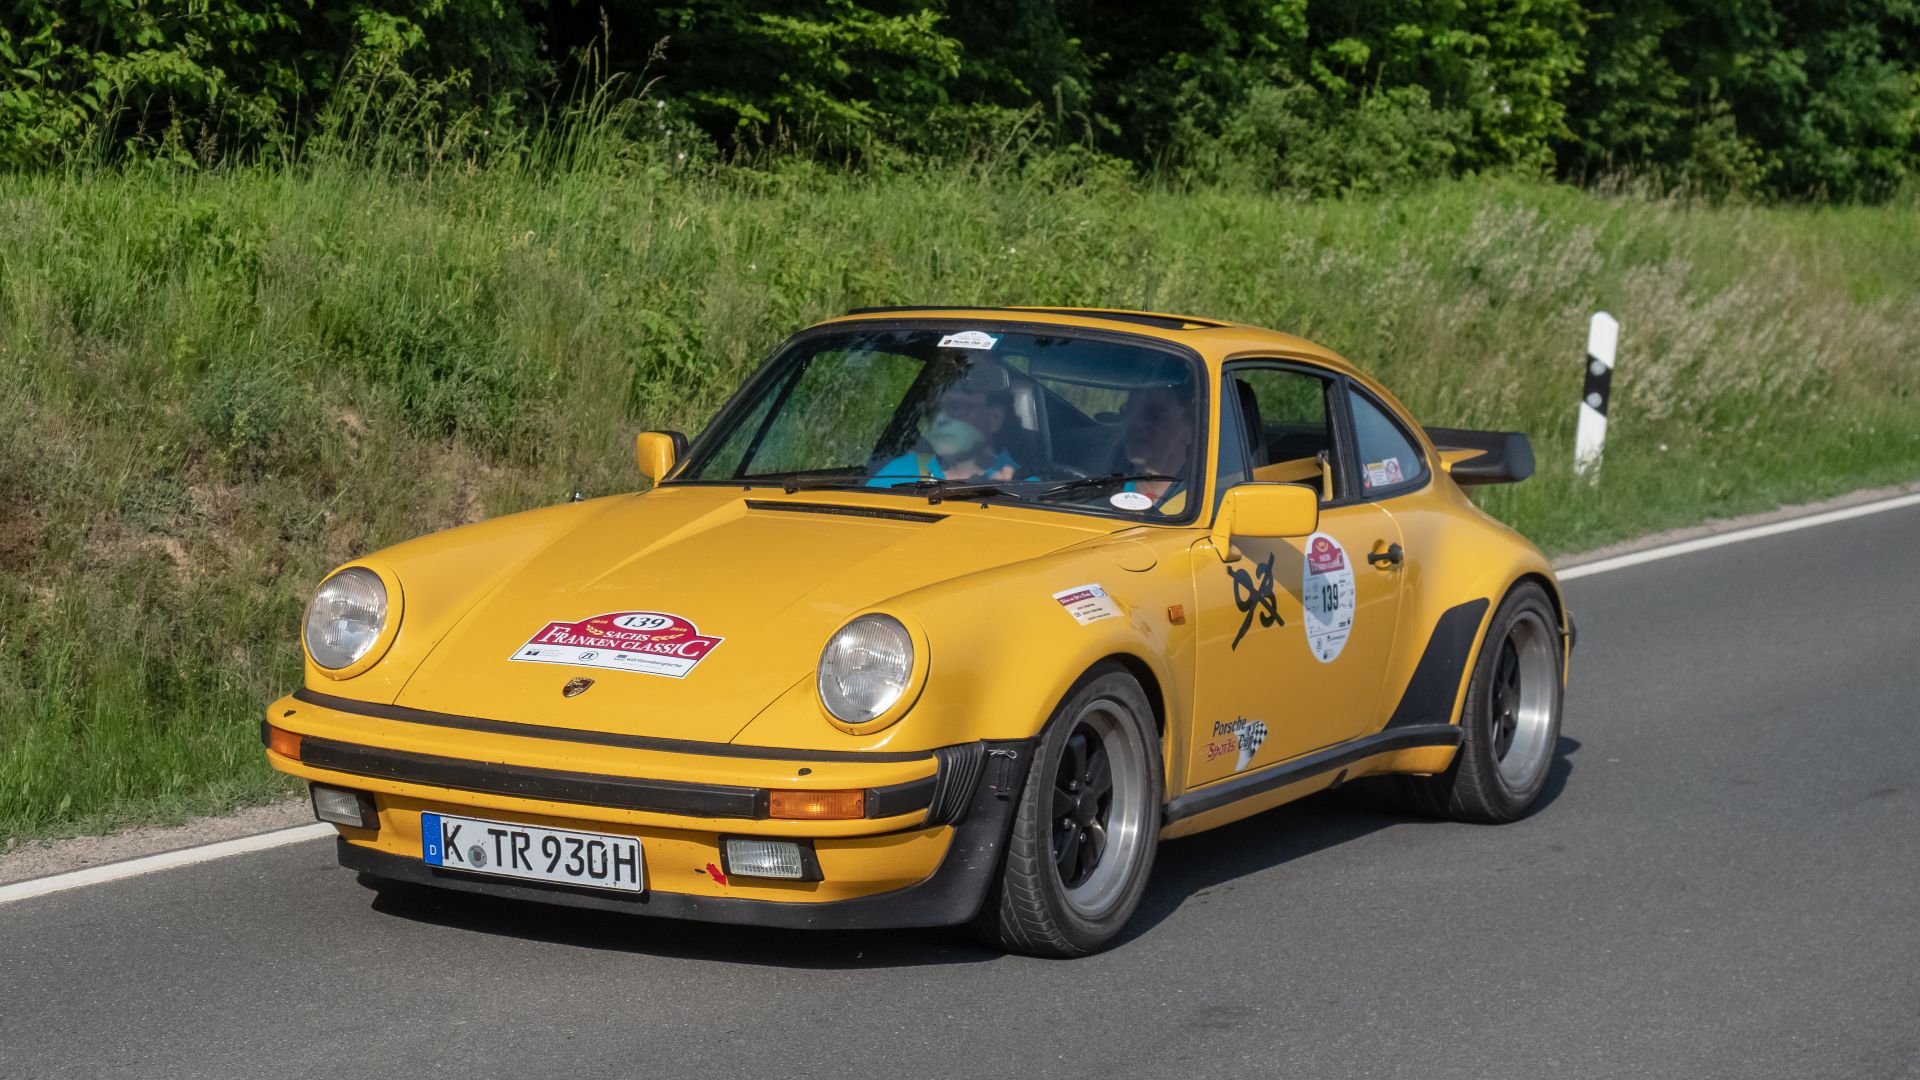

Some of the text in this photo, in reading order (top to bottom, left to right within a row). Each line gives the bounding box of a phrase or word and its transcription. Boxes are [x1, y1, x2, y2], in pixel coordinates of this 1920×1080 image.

[1322, 583, 1339, 613] 139
[623, 616, 665, 629] 139
[538, 625, 711, 657] FRANKEN CLASSIC
[603, 630, 651, 641] SACHS
[1213, 715, 1247, 737] Porsche
[429, 844, 437, 856] D
[442, 822, 637, 884] K TR 930H
